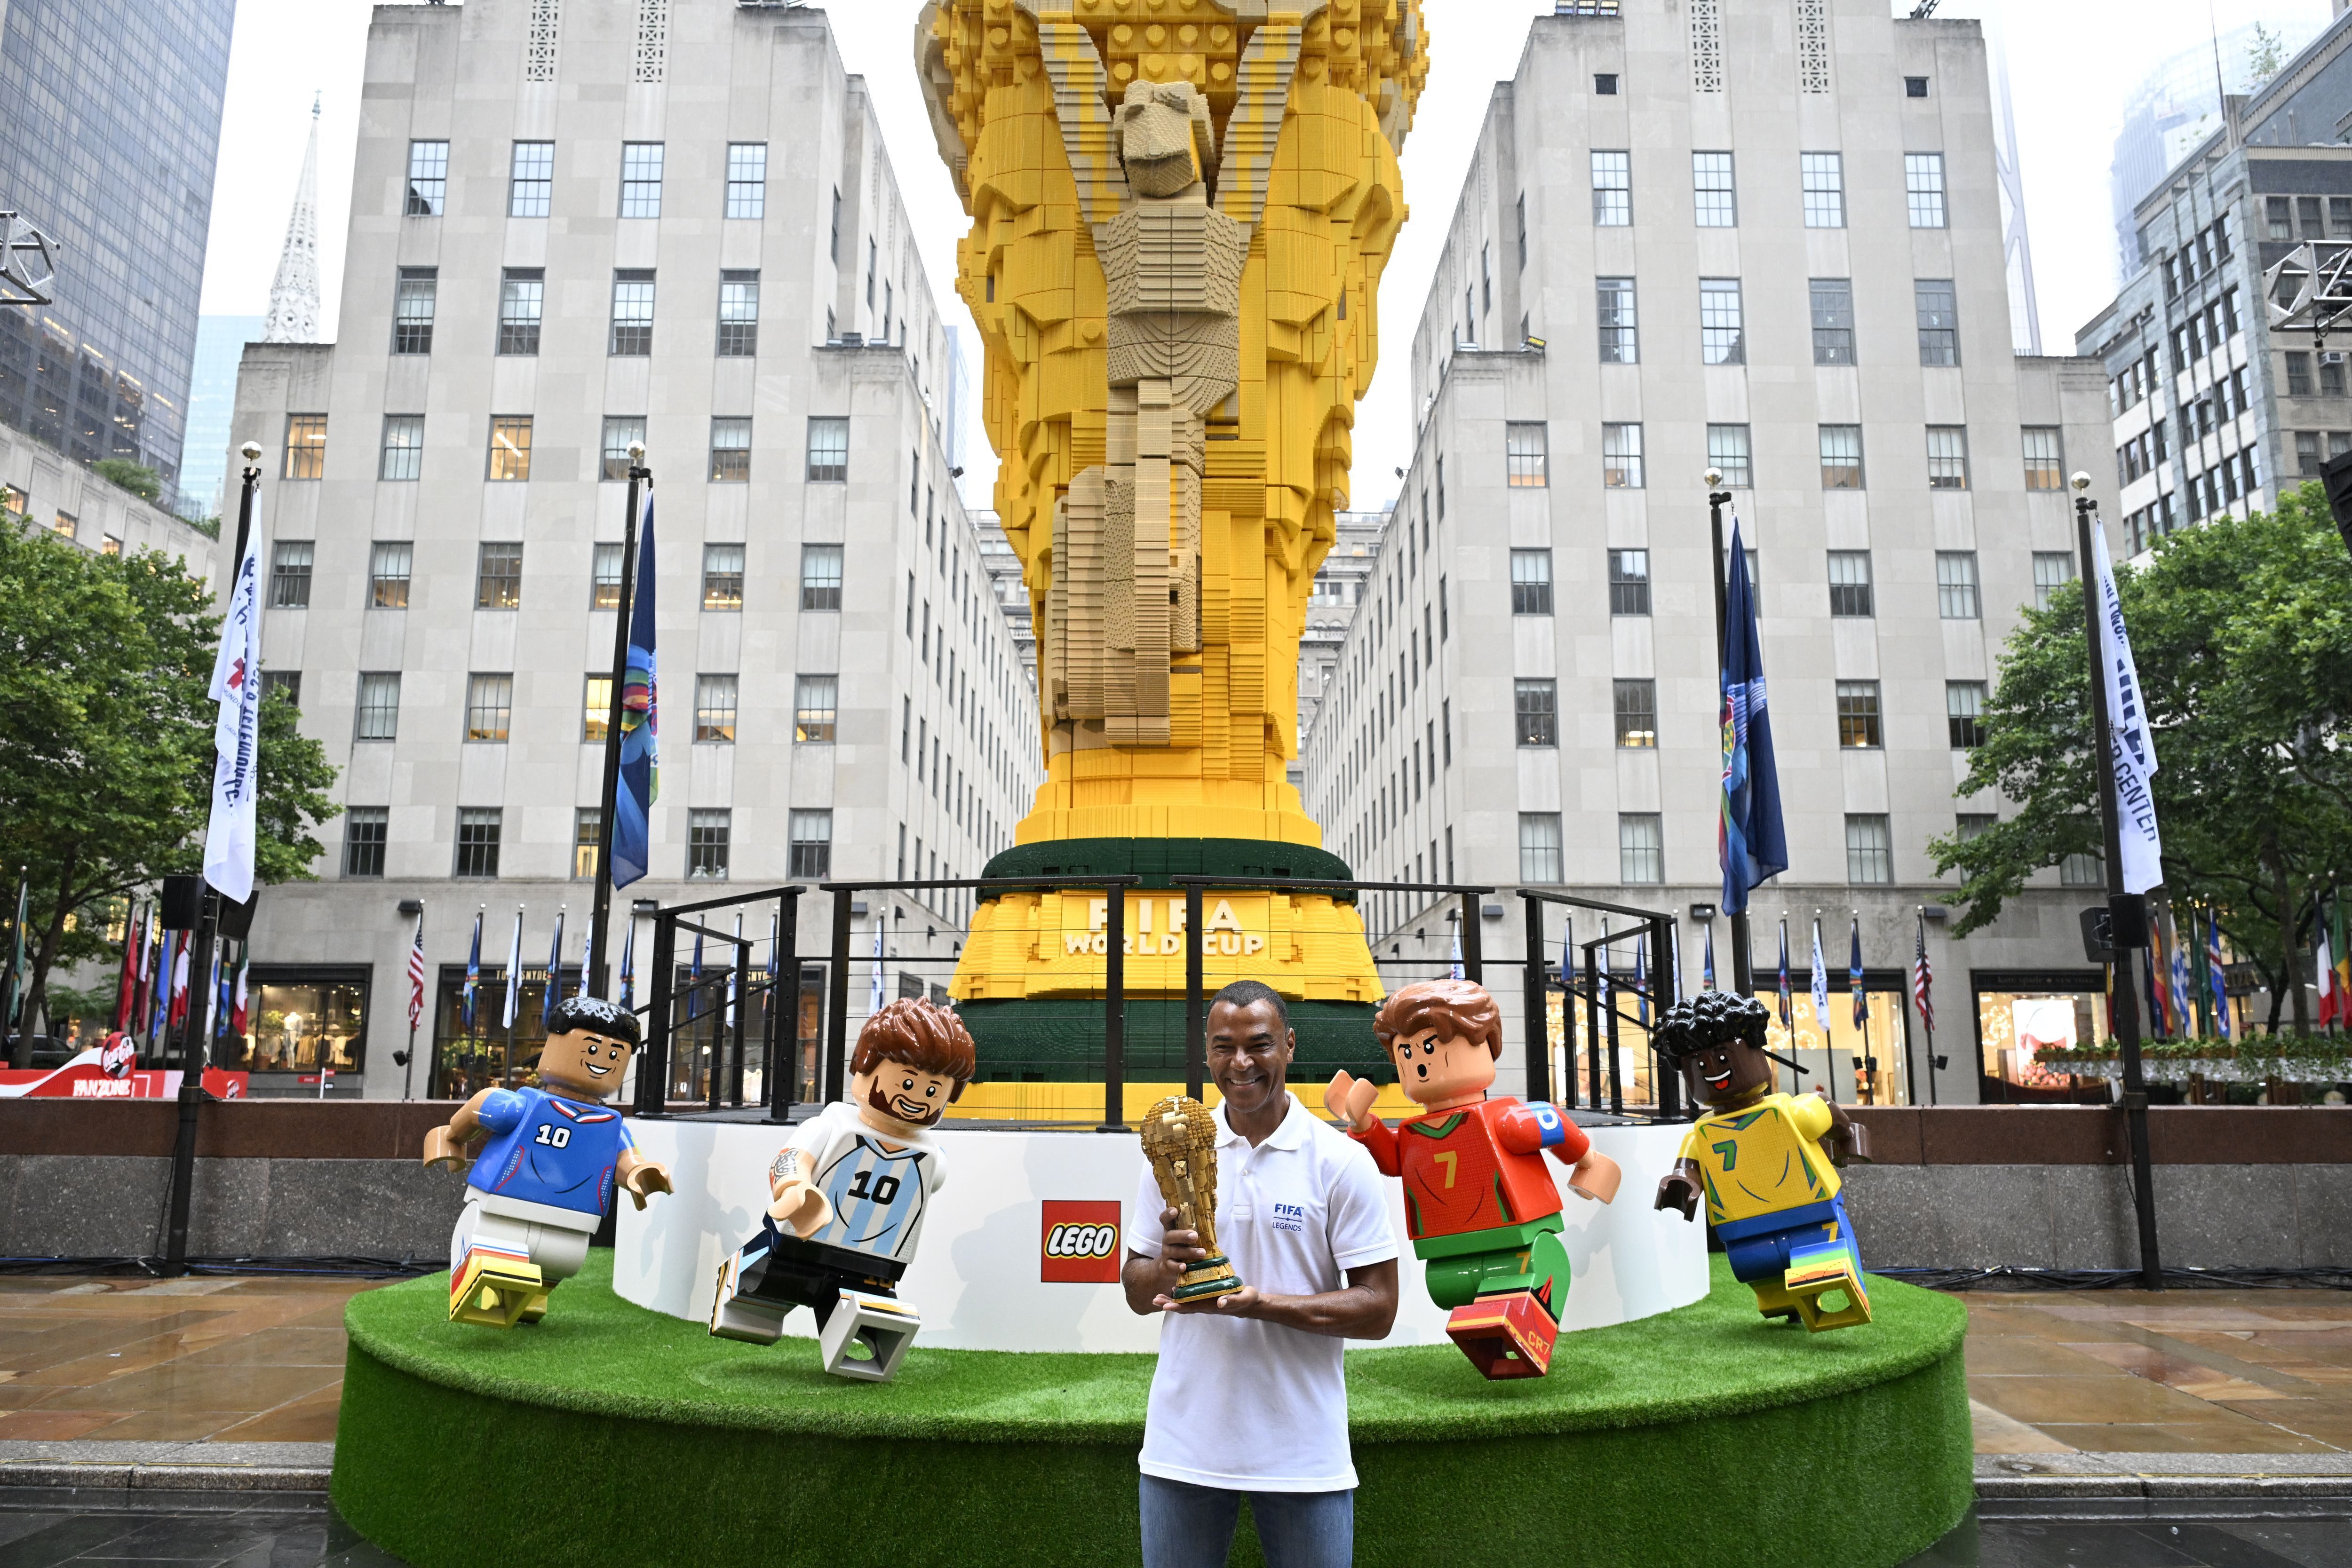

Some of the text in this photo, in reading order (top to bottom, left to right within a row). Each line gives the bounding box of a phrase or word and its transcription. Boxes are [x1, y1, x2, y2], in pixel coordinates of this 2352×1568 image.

[1089, 899, 1243, 934] FIFA
[1203, 935, 1263, 956] CUP
[522, 970, 547, 980] SNYDE
[535, 1124, 571, 1148] 10
[1712, 1140, 1737, 1172] 7
[1433, 1150, 1457, 1188] 7
[847, 1171, 900, 1205] 10
[1275, 1204, 1303, 1217] FIFA
[1272, 1222, 1301, 1231] LEGENDS
[1822, 1221, 1838, 1243] 7
[1046, 1224, 1116, 1257] LEGO
[1516, 1251, 1531, 1275] 7
[1528, 1331, 1550, 1355] CR7
